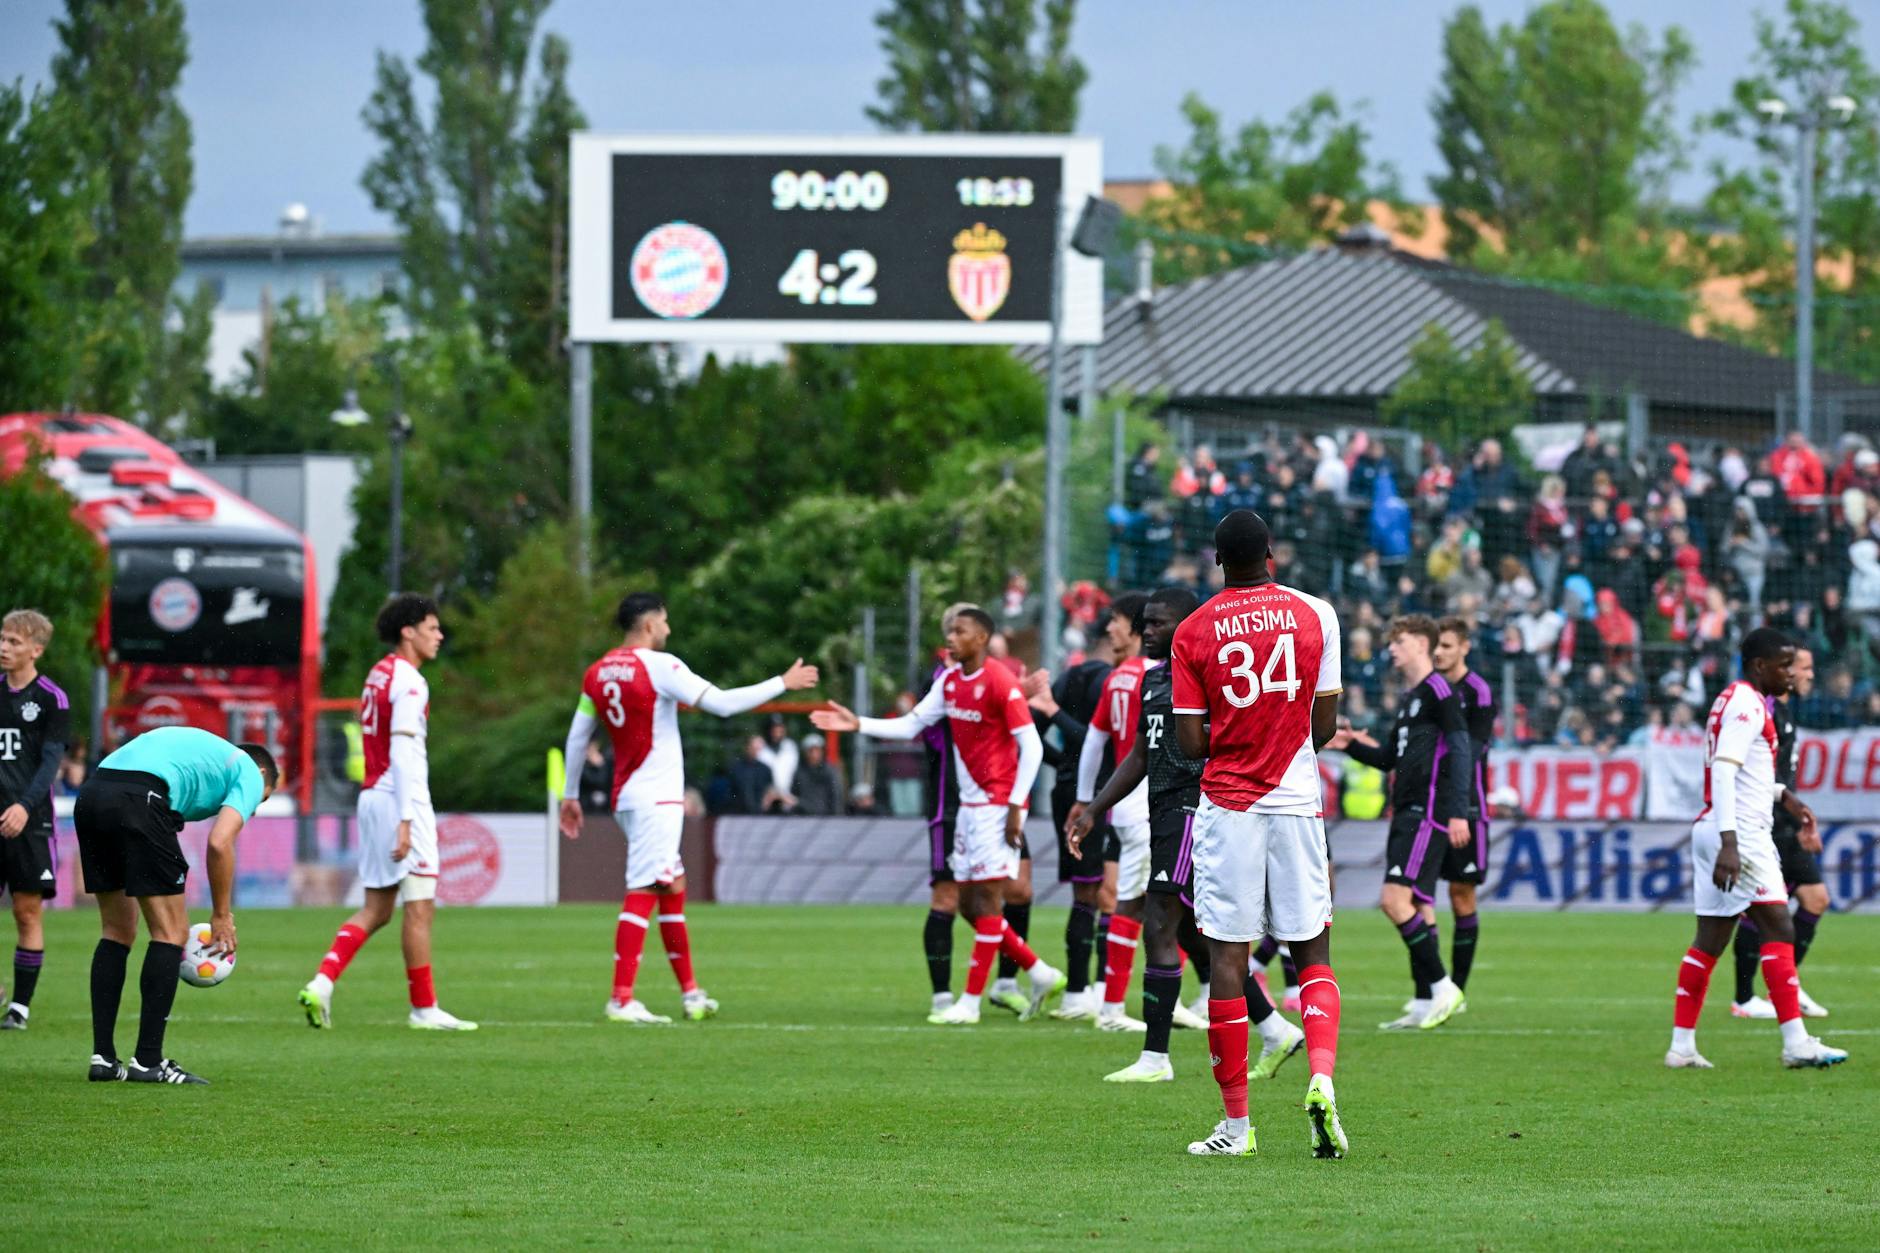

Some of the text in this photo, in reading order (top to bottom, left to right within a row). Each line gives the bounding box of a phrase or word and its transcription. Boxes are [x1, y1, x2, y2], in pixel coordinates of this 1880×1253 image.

[771, 170, 889, 210] 90:00
[778, 249, 877, 304] 4:2
[1215, 600, 1240, 611] BANG
[1218, 633, 1302, 708] 34
[603, 681, 625, 728] 3
[1496, 828, 1692, 902] Allia
